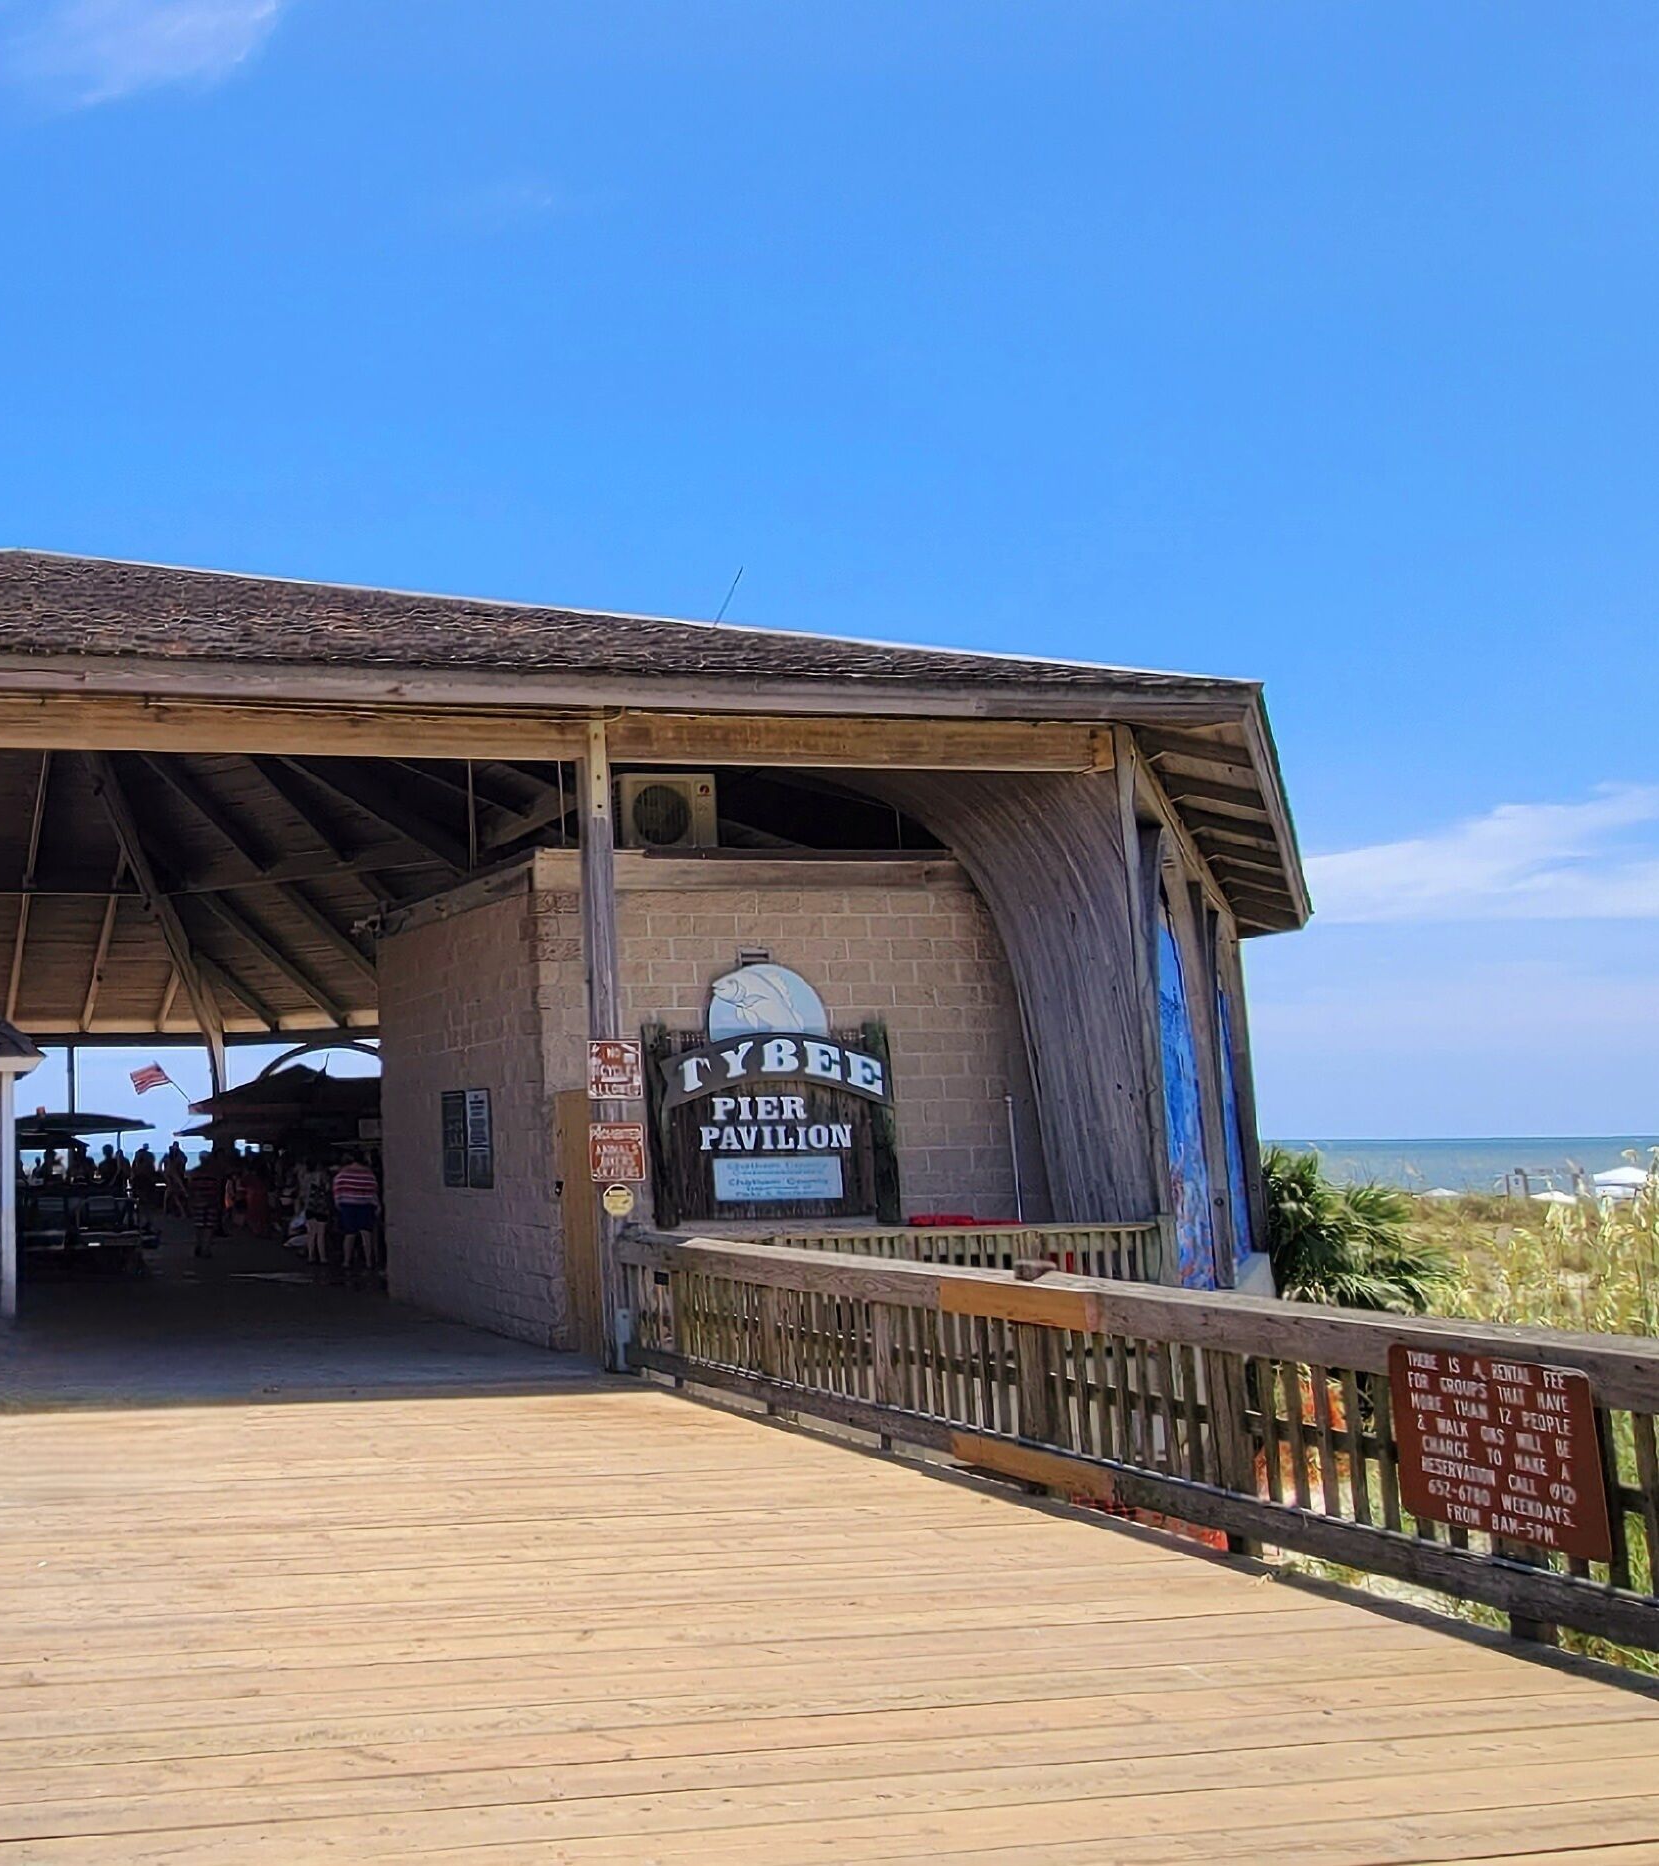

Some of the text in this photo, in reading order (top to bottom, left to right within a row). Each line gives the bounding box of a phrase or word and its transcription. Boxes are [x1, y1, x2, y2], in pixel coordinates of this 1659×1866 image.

[678, 1038, 883, 1096] TYBEE
[712, 1096, 807, 1120] PIER
[699, 1124, 852, 1150] PAVILION
[1406, 1350, 1439, 1370] THERE
[1448, 1356, 1460, 1374] IS
[1491, 1363, 1533, 1386] RENTAL
[1543, 1371, 1566, 1390] FEE
[1407, 1371, 1570, 1414] FOR GROUPS THAT HAVE
[1410, 1392, 1573, 1436] MORE THAN 12 PEOPLE
[1417, 1414, 1573, 1459] & WALK ONS WILL BE
[1421, 1456, 1496, 1487] RESERVATION
[1508, 1474, 1539, 1496] CALL
[1486, 1447, 1502, 1466] TO
[1514, 1453, 1549, 1477] MAKE
[1561, 1464, 1571, 1481] A
[1428, 1479, 1492, 1507] 652-6780
[1447, 1503, 1481, 1526] FROM
